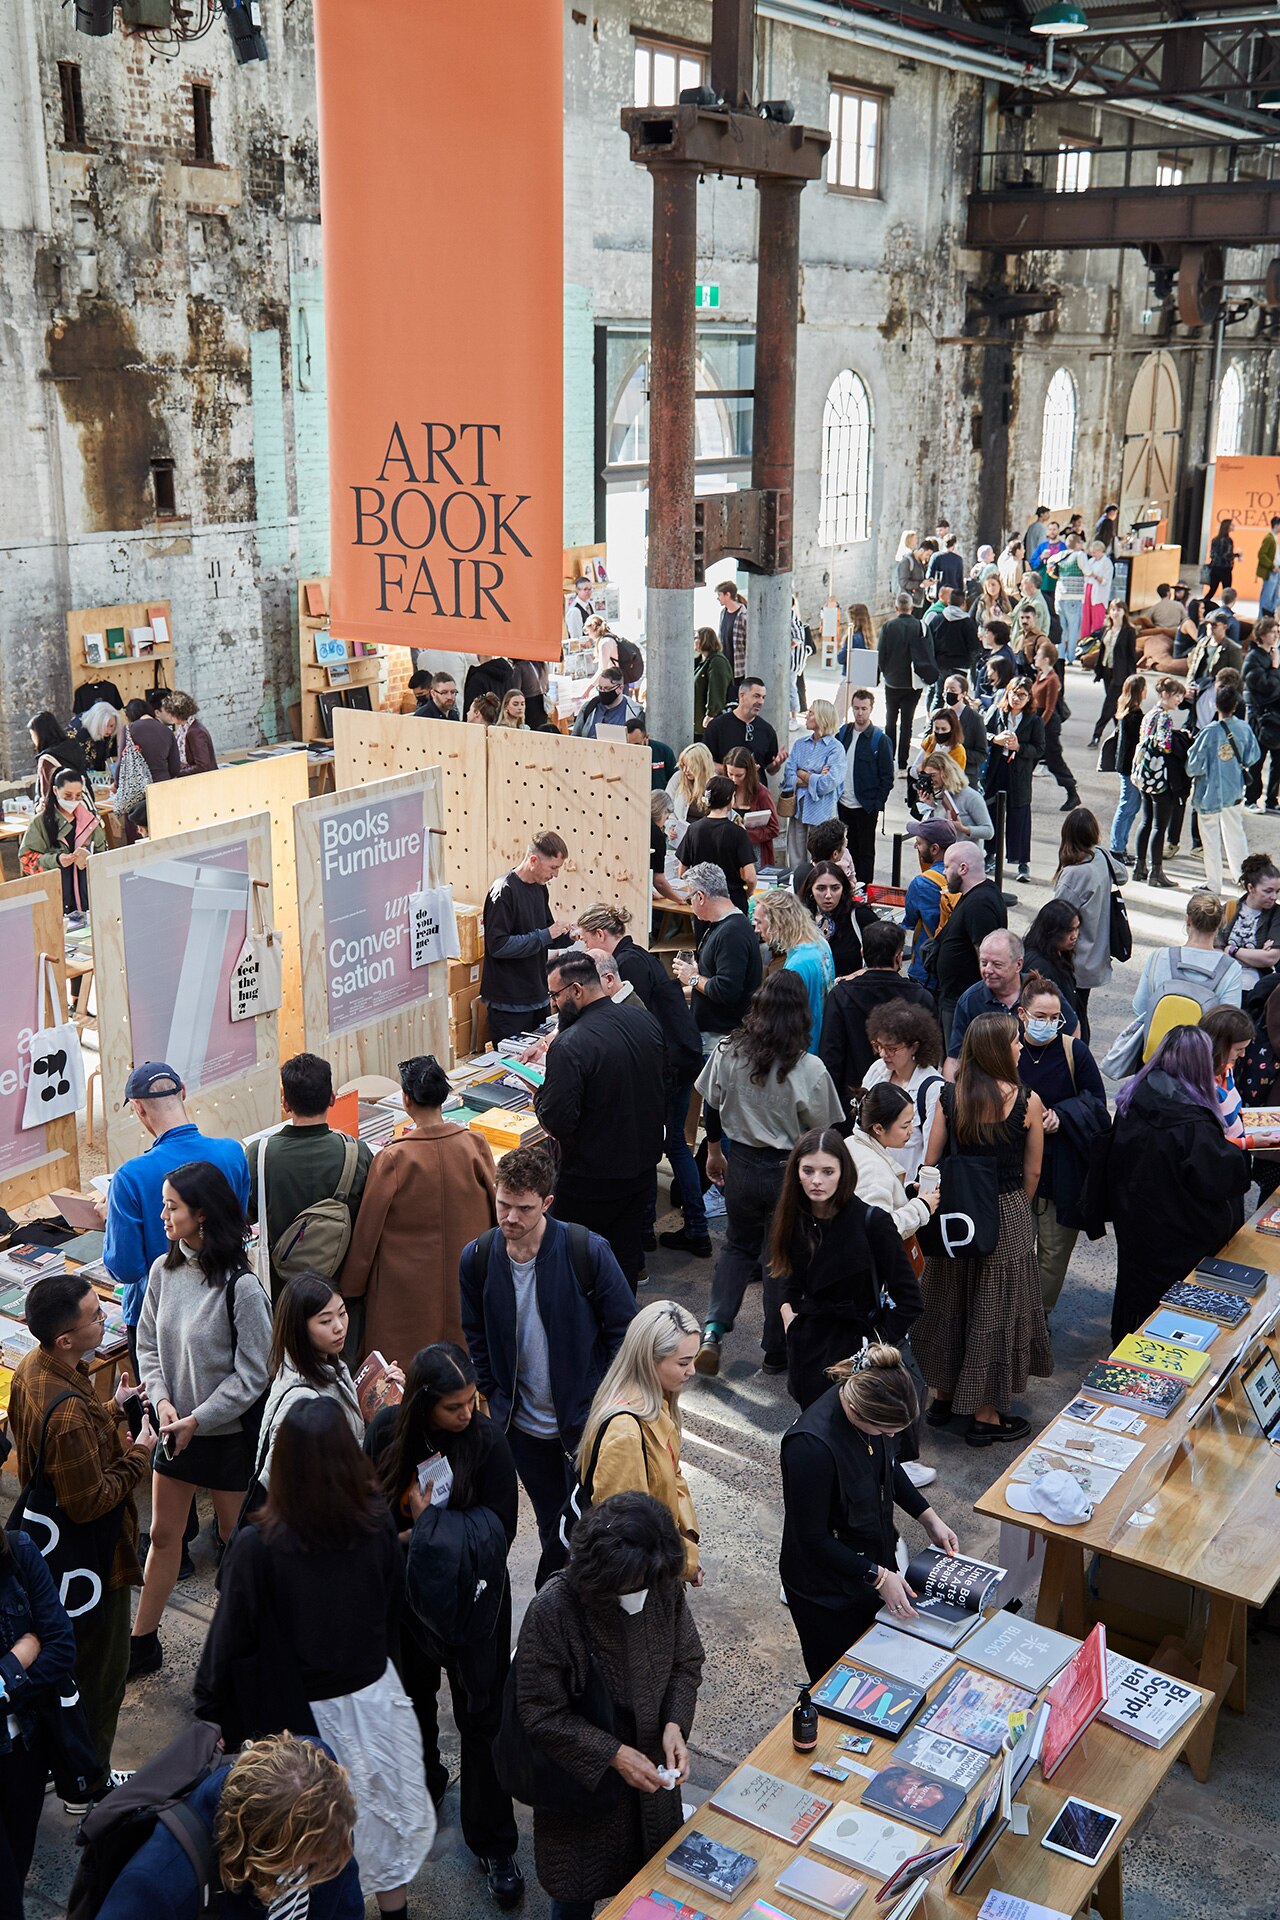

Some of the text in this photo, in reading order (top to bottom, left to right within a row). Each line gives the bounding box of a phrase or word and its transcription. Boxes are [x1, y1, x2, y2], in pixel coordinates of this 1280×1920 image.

[376, 421, 500, 486] ART
[1246, 491, 1273, 509] TO
[349, 486, 533, 558] BOOK
[374, 552, 512, 622] FAIR
[323, 809, 390, 851] Books
[324, 832, 421, 881] Furniture
[416, 909, 428, 920] do
[416, 918, 433, 929] you
[416, 924, 440, 940] read
[416, 938, 430, 949] me
[329, 924, 410, 968] Conver-
[237, 962, 260, 977] feel
[331, 957, 395, 998] sation
[238, 977, 256, 989] the
[238, 988, 259, 1002] hug
[940, 1212, 976, 1258] P
[937, 1559, 962, 1590] Japan's
[956, 1564, 974, 1577] The
[967, 1568, 985, 1586] Little
[946, 1578, 962, 1600] Arts
[984, 1625, 1022, 1657] BLOCKS
[835, 1664, 883, 1685] BOOKS
[1120, 1668, 1149, 1692] ual
[908, 1688, 920, 1697] A
[1120, 1676, 1171, 1719] Script
[1164, 1684, 1192, 1707] Bi-
[860, 1710, 900, 1731] BOOK
[949, 1752, 979, 1782] HONGKONG
[964, 1755, 988, 1780] MADE IN
